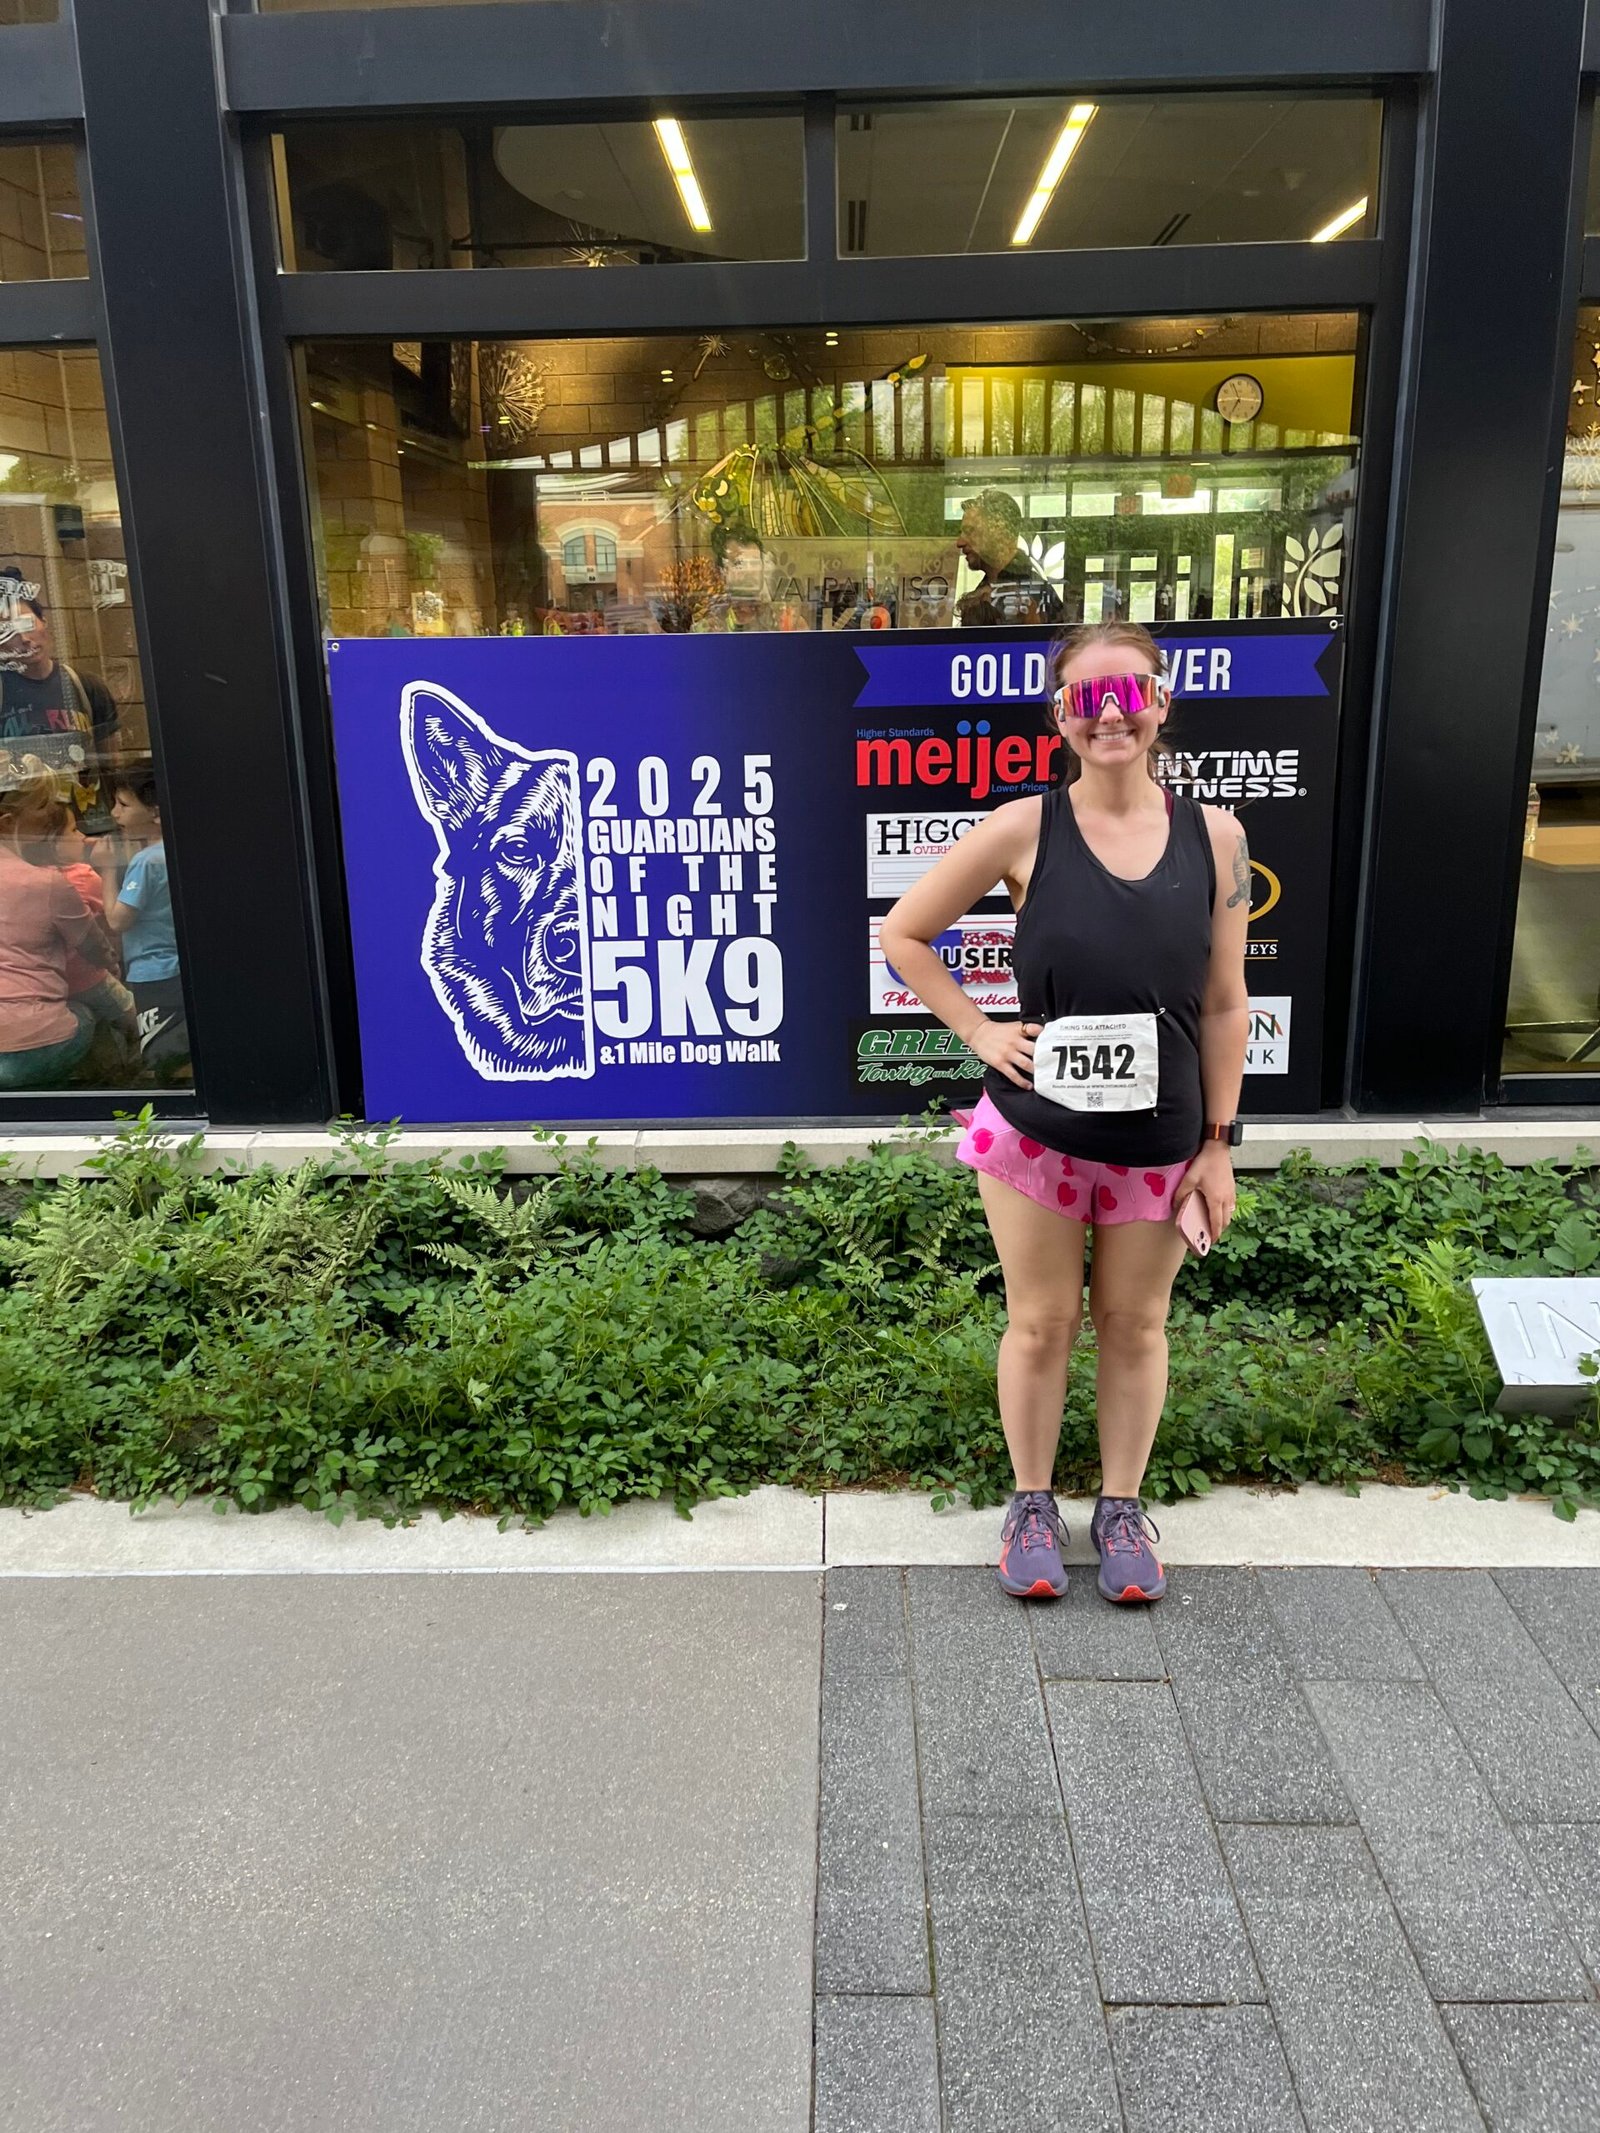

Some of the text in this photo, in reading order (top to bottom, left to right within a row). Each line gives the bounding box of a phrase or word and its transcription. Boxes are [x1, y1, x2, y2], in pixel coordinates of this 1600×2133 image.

[951, 648, 1232, 698] GOLD VER
[856, 727, 935, 740] Higher Standards
[856, 720, 1062, 799] meijer
[1153, 750, 1299, 778] NYTIME
[586, 755, 774, 817] 2025
[991, 782, 1050, 794] Lower Prices
[588, 817, 776, 855] GUARDIANS
[913, 845, 952, 856] OVERH
[590, 853, 777, 893] OF THE
[592, 893, 777, 938] NIGHT
[943, 947, 1013, 970] USER
[591, 936, 784, 1039] 5K9
[136, 1006, 159, 1037] KE
[629, 1042, 676, 1064] Mile
[680, 1041, 722, 1065] Dog
[725, 1040, 781, 1062] Walk
[1052, 1043, 1135, 1080] 7542
[857, 1062, 934, 1087] Towing
[932, 1068, 954, 1079] and
